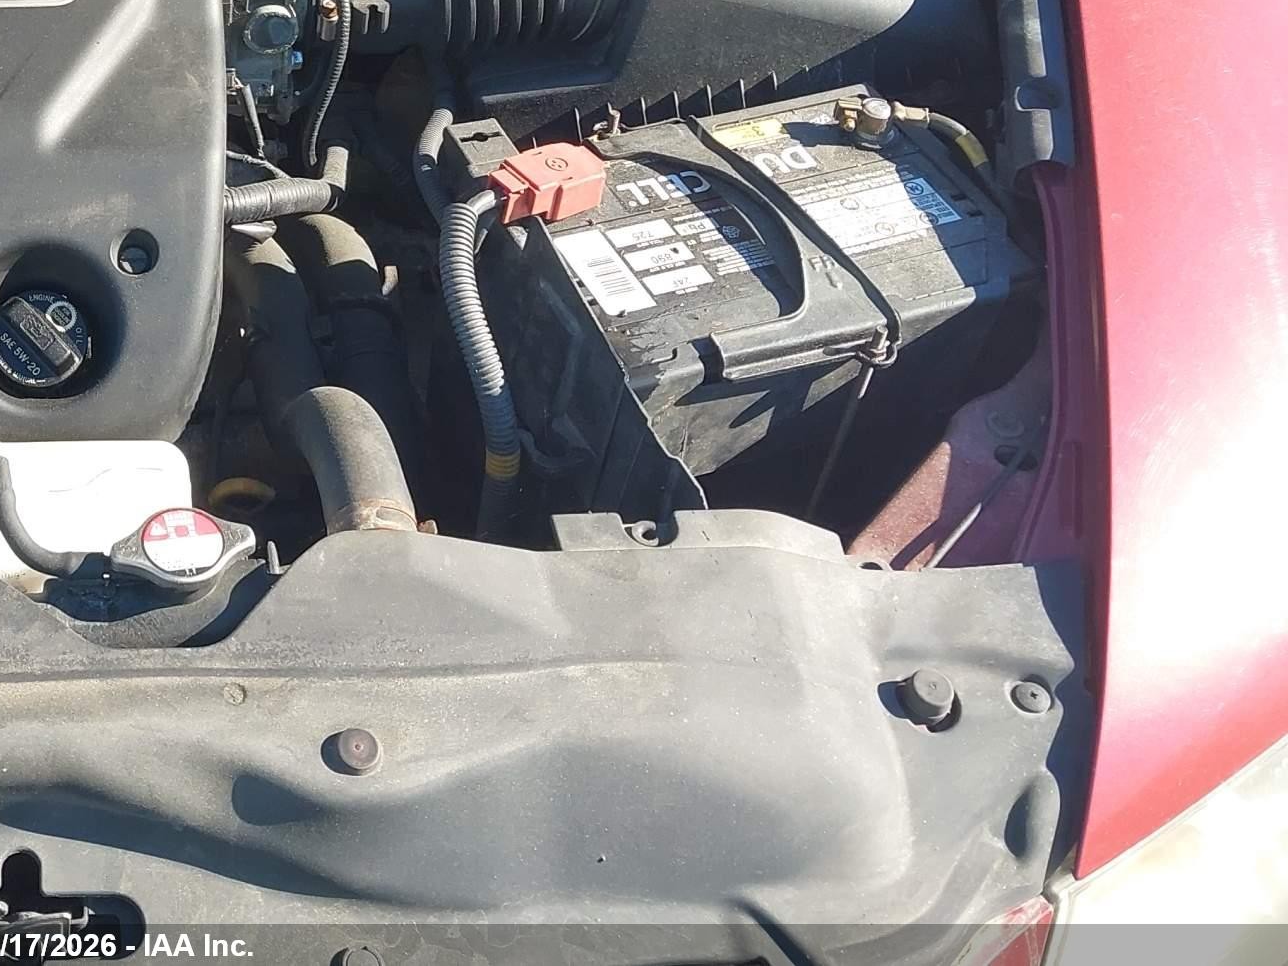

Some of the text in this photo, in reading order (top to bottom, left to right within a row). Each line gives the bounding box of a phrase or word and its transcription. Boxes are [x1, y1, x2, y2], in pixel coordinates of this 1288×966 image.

[28, 293, 84, 345] ENGINE OIL
[0, 332, 41, 376] SAE 5W-20
